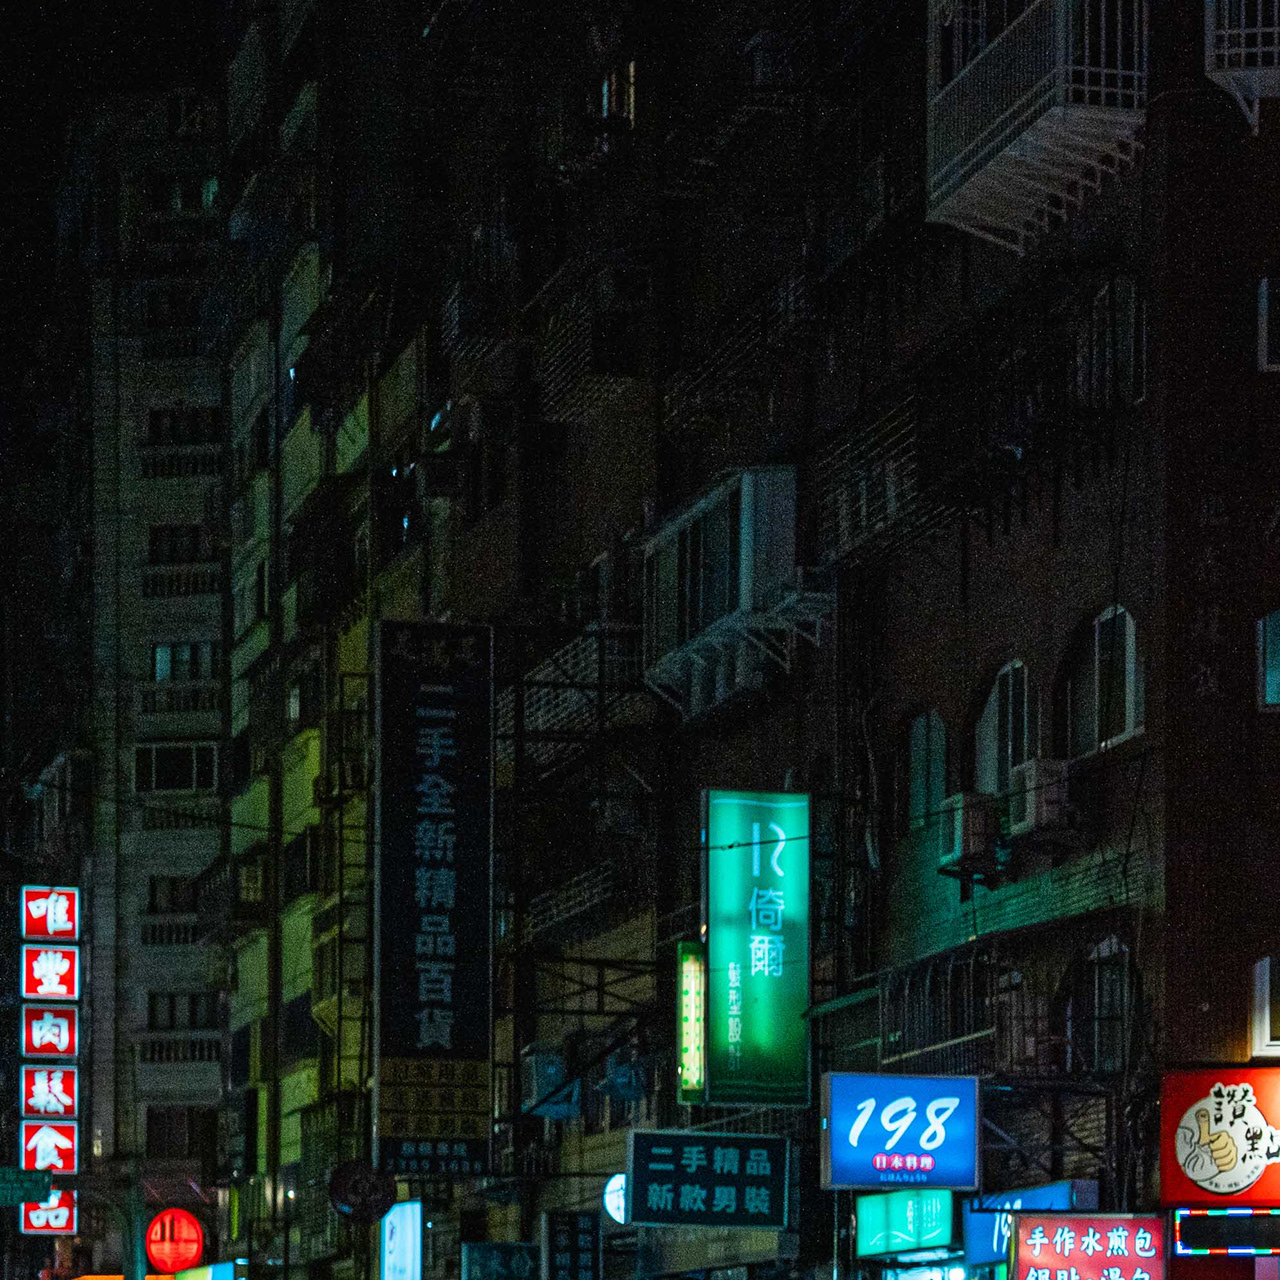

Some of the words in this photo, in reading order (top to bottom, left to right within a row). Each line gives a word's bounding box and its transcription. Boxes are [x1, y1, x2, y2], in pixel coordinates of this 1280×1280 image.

[848, 1096, 961, 1151] 198
[647, 1146, 772, 1177] 二手精品
[875, 1155, 933, 1170] 日本料理
[646, 1181, 772, 1217] 新款男裝
[1026, 1225, 1156, 1259] 手作水煎包
